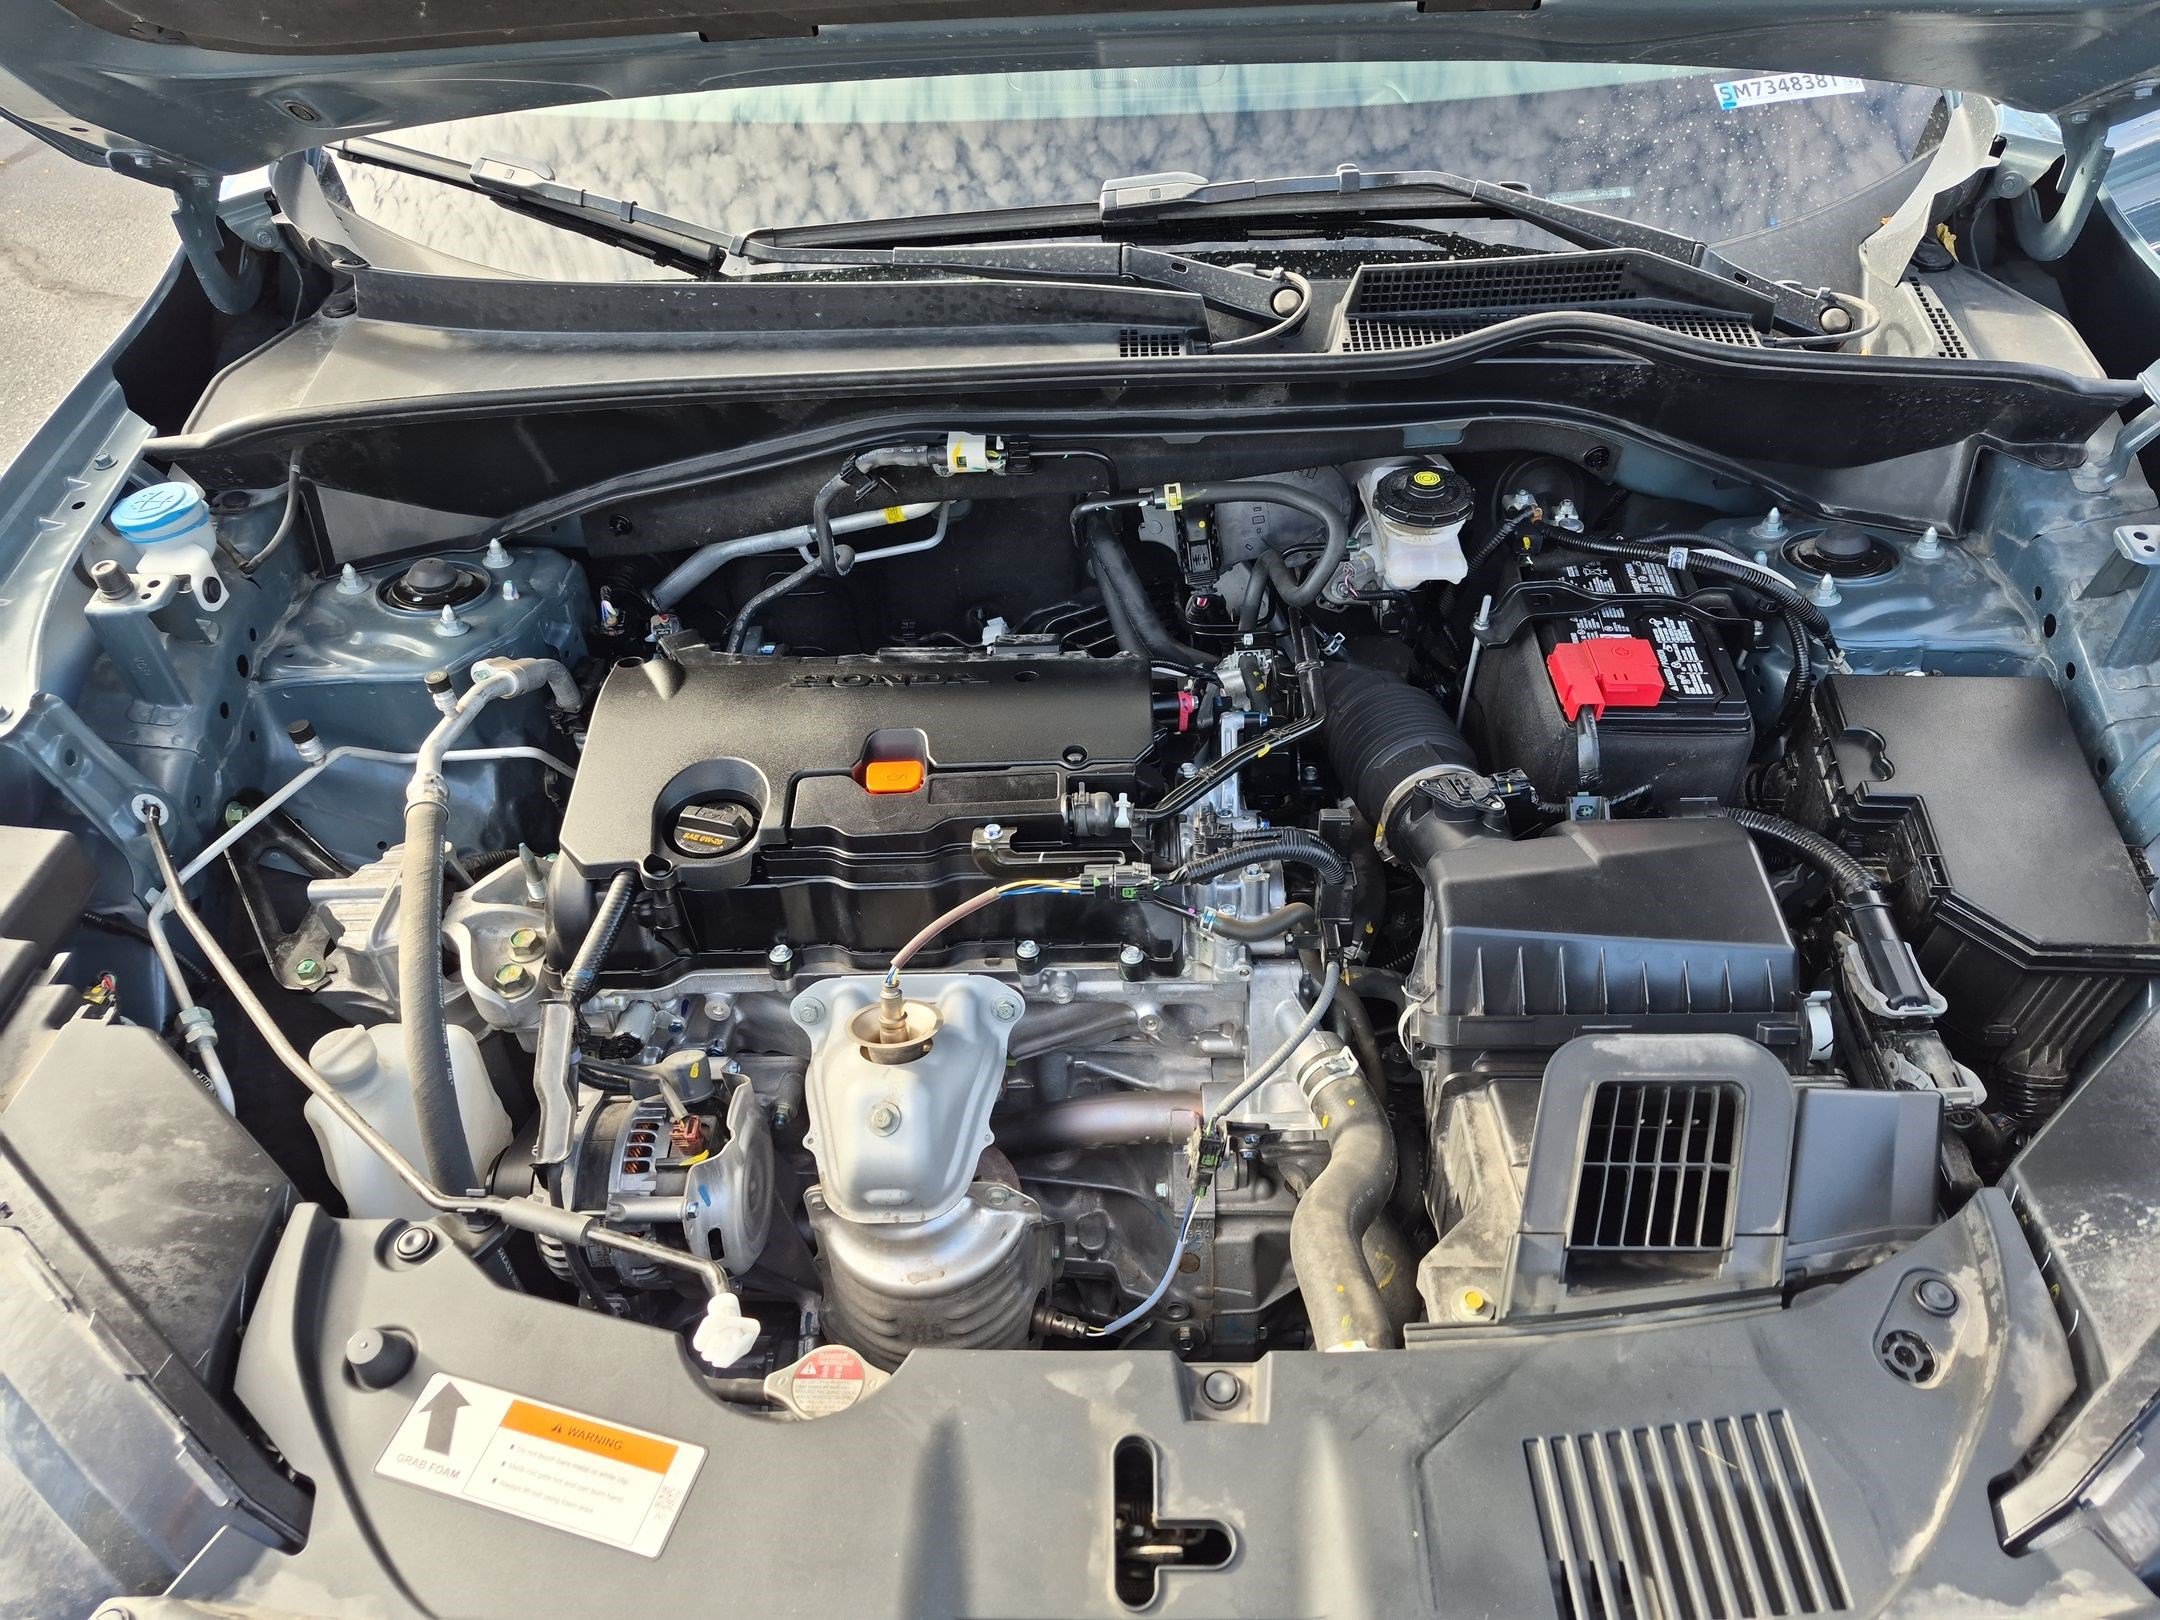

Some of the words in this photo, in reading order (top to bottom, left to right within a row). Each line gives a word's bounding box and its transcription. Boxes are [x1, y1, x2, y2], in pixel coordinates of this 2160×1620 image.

[789, 672, 990, 688] HONDA
[682, 832, 701, 841] SAE
[699, 835, 724, 846] 0W-20
[567, 1426, 624, 1450] WARNING
[396, 1453, 428, 1470] GRAB
[429, 1462, 461, 1480] FOAM
